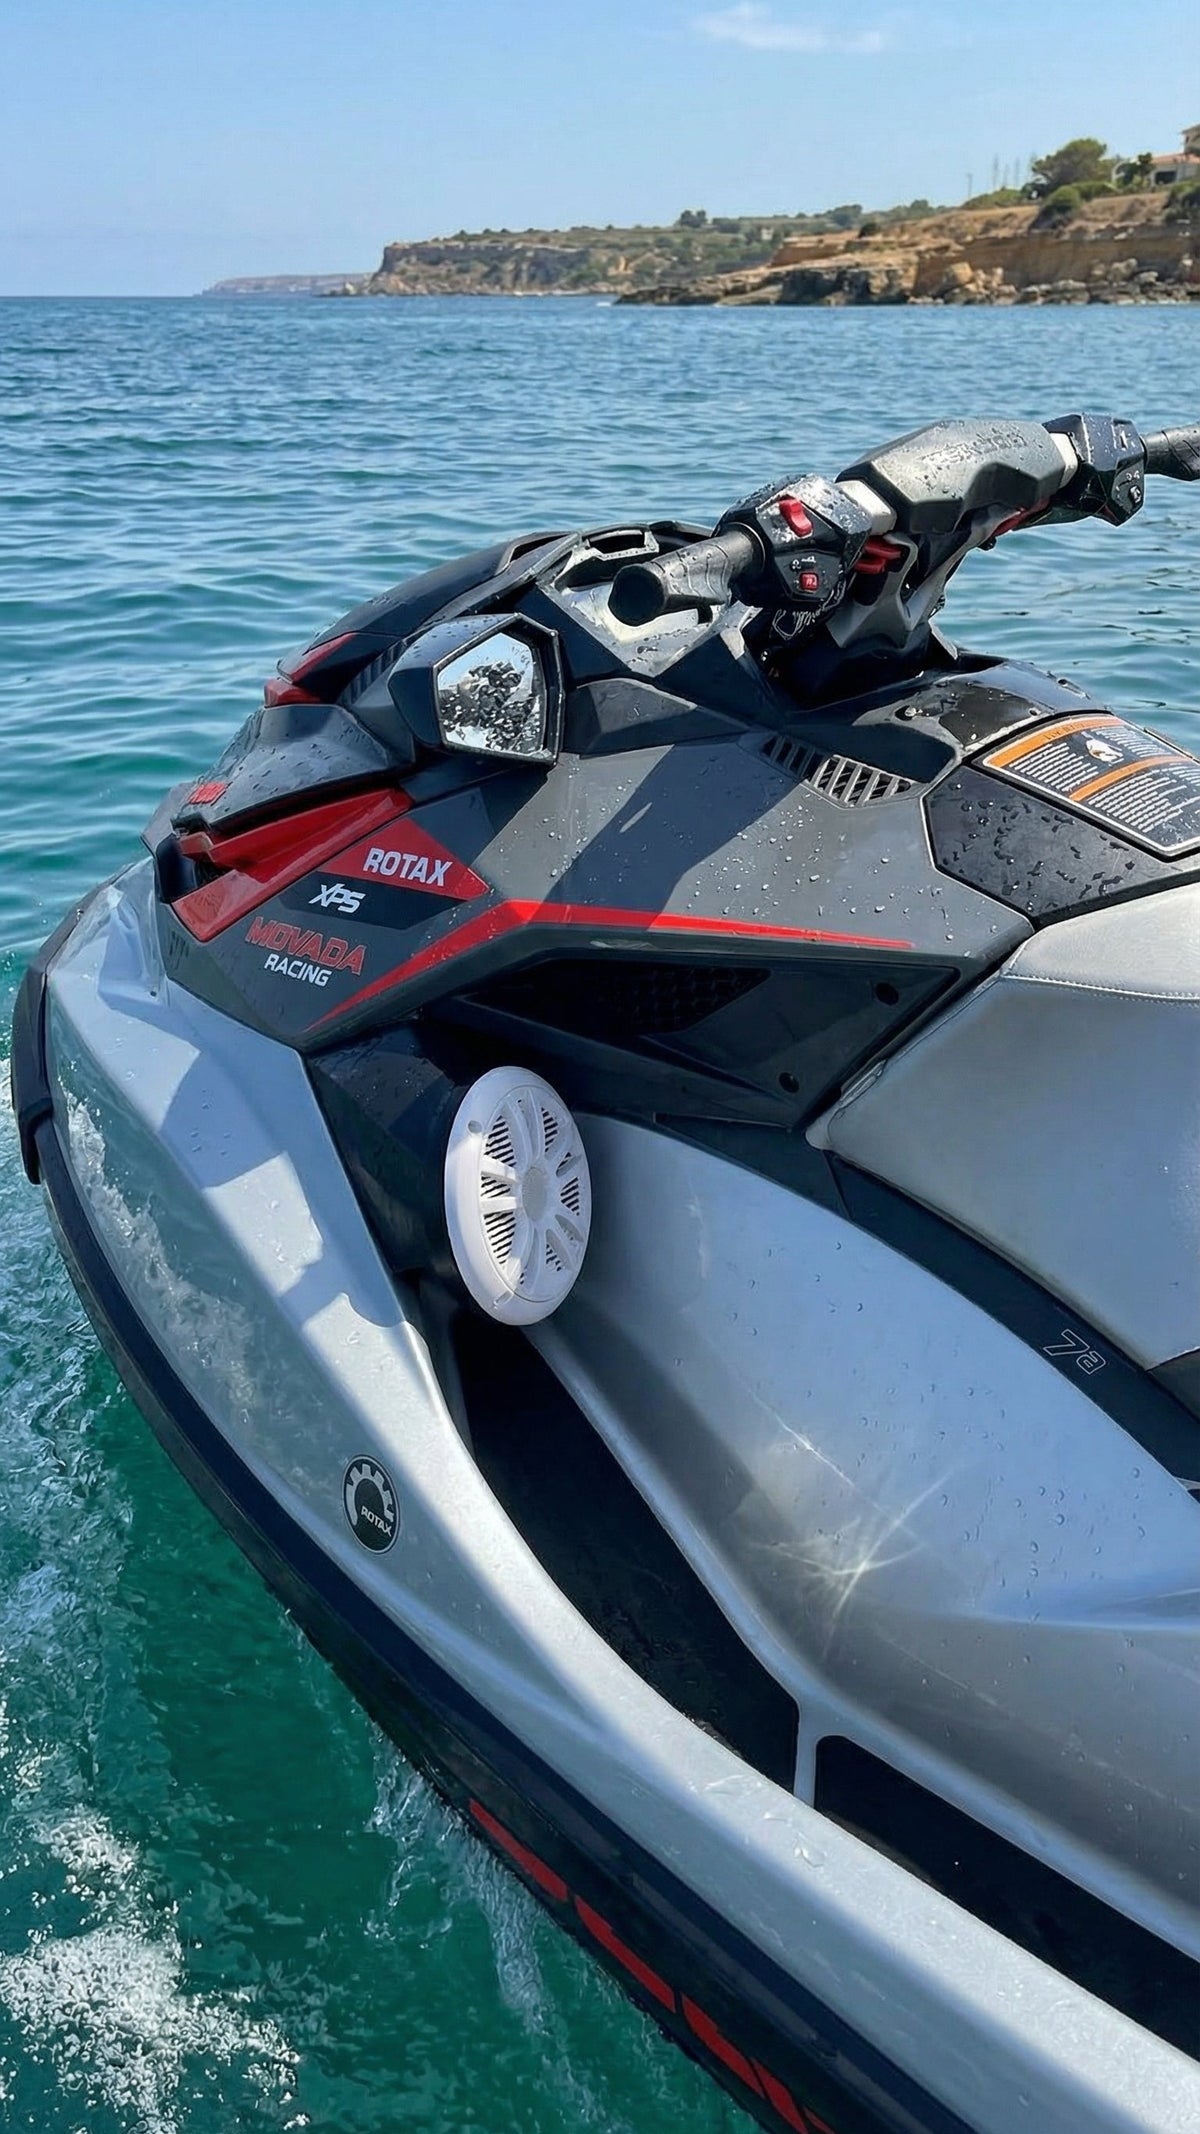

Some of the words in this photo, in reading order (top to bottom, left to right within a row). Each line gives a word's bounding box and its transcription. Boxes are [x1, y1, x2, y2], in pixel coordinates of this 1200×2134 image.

[363, 847, 453, 887] ROTAX
[308, 883, 366, 914] XPS
[245, 916, 368, 976] MOVADA
[263, 953, 332, 987] RACING
[361, 1505, 392, 1537] ROTAX
